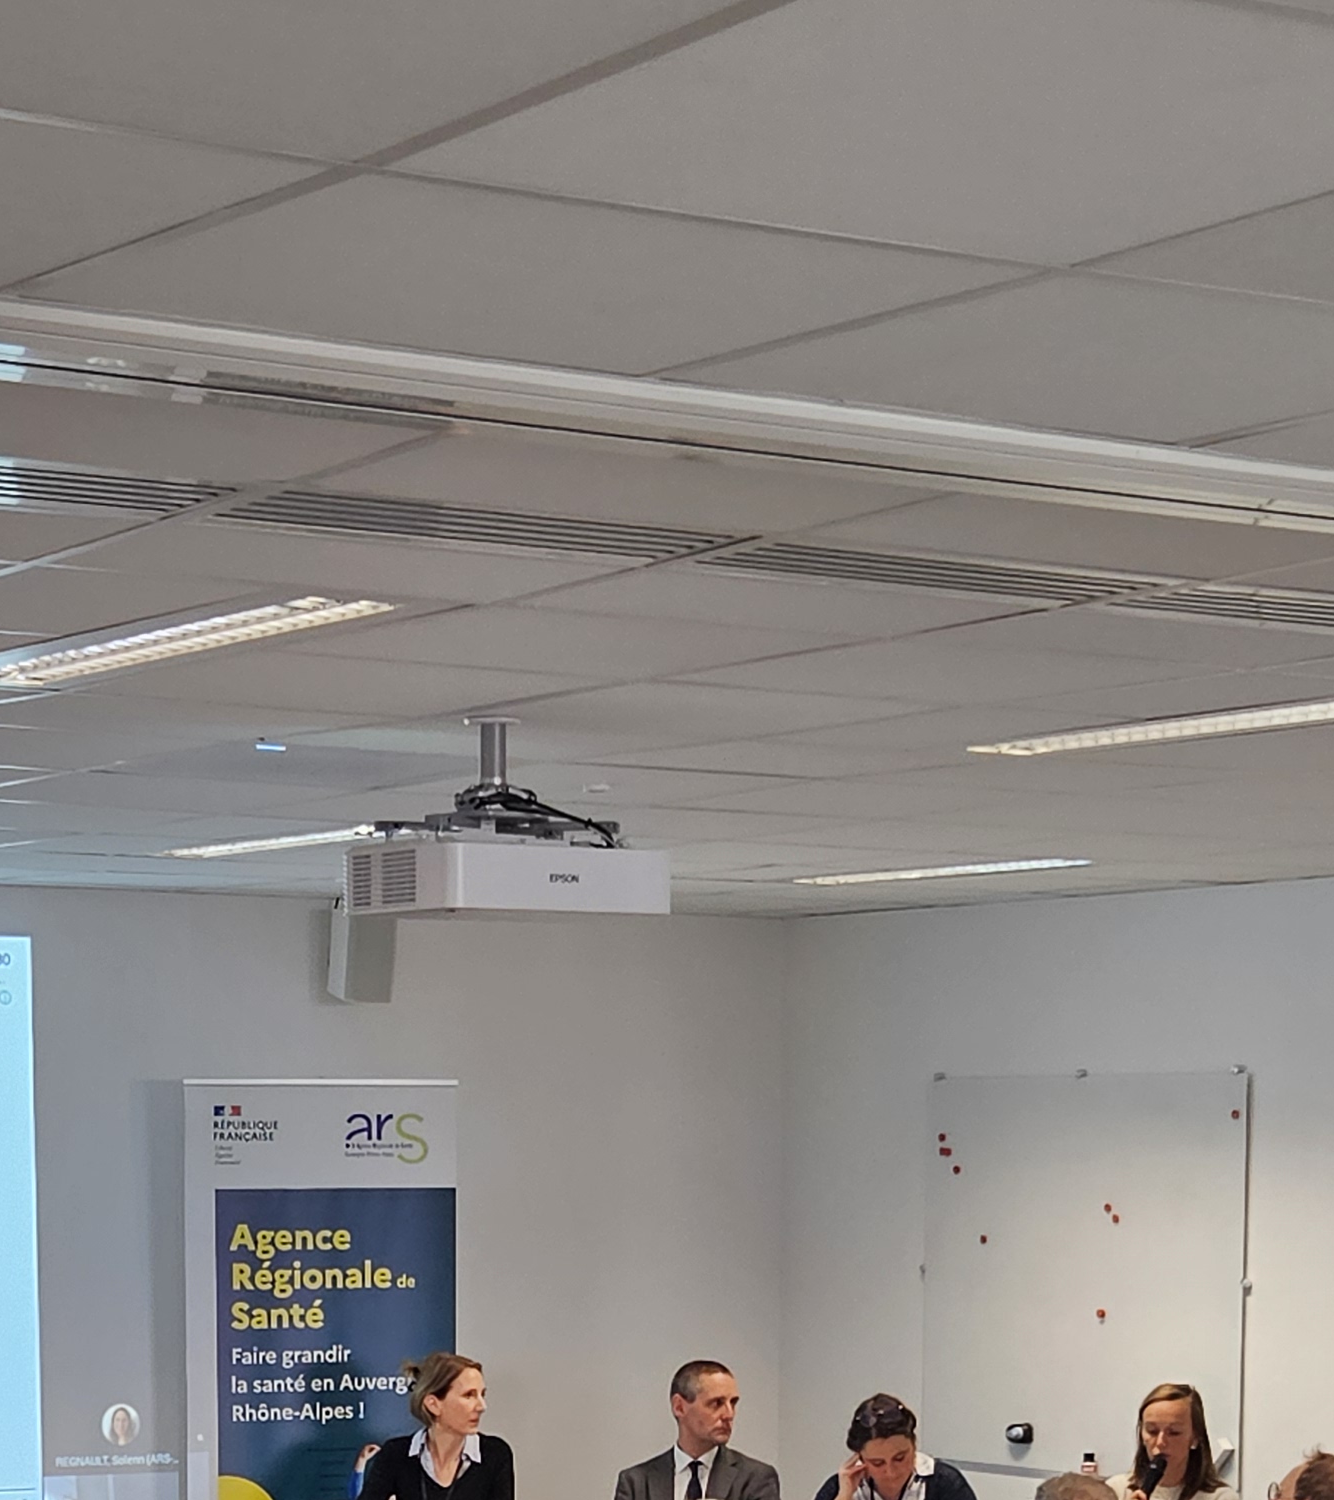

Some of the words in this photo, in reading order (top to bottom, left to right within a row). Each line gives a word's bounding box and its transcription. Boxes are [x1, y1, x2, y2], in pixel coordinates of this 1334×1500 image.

[549, 874, 579, 885] EPSON
[212, 1118, 278, 1132] RÉPUBLIQUE
[212, 1131, 274, 1143] FRANÇAISE
[345, 1113, 429, 1164] ars
[230, 1223, 351, 1260] Agence
[231, 1260, 393, 1298] Régionale
[396, 1273, 416, 1289] de
[230, 1299, 325, 1331] Santé
[232, 1347, 277, 1366] Faire
[282, 1345, 351, 1369] grandir
[231, 1375, 248, 1394] la
[253, 1372, 305, 1393] santé
[311, 1376, 335, 1392] en
[340, 1373, 413, 1396] Auverg
[232, 1401, 354, 1425] Rhône-Alpes
[358, 1401, 365, 1419] !
